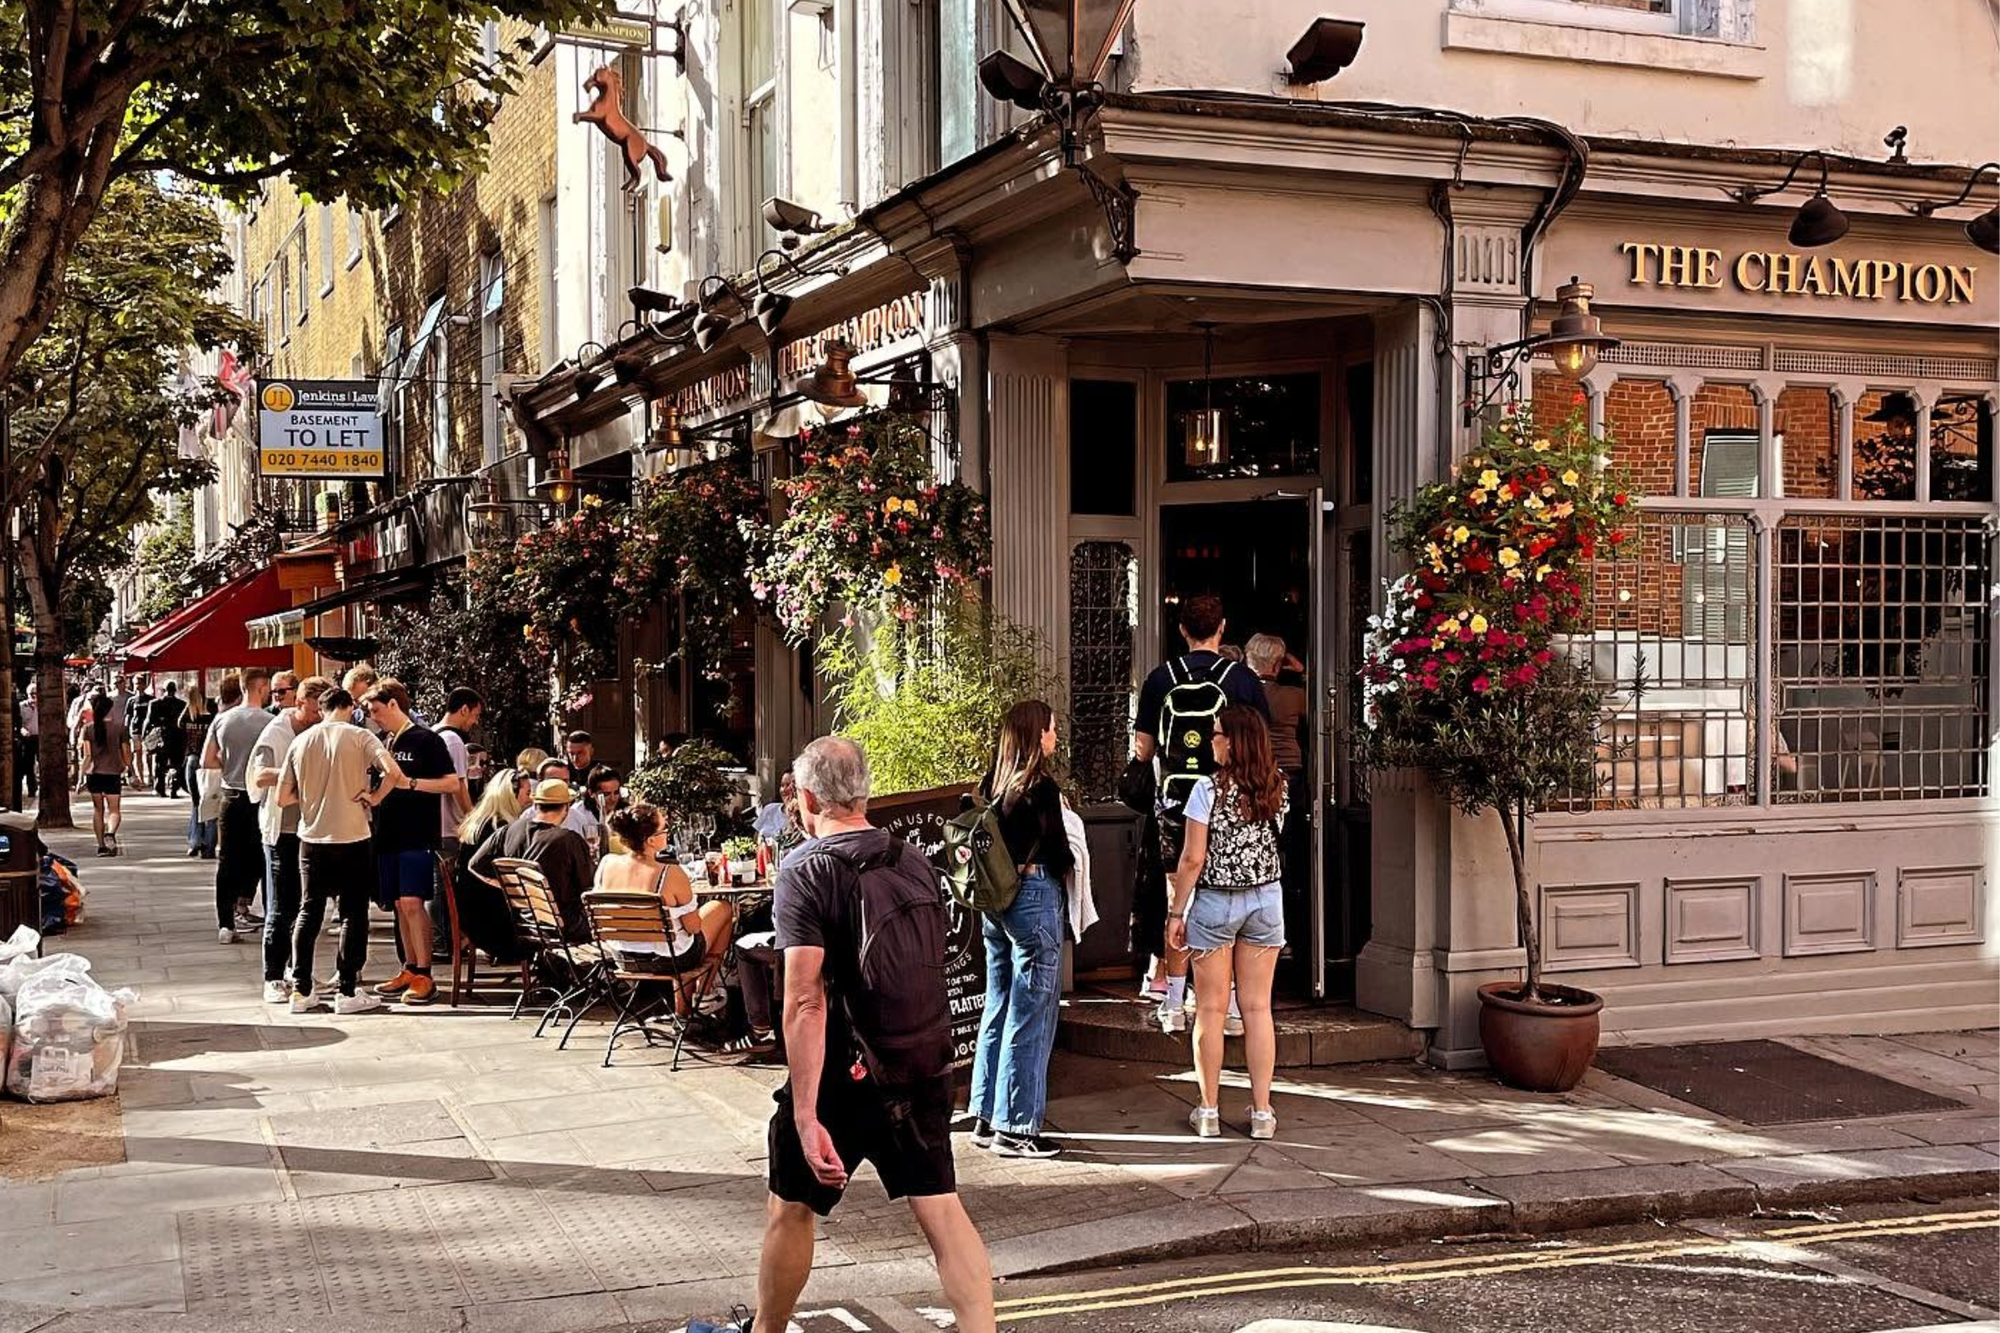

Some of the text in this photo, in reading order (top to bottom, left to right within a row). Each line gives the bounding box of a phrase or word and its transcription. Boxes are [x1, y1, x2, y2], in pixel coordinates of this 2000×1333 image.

[590, 23, 645, 39] HAMPION
[1623, 242, 1978, 304] THE CHAMPION
[779, 335, 813, 378] THE
[297, 389, 378, 406] Jenkins Law
[676, 364, 747, 415] CHAMPION
[290, 414, 359, 426] BASEMENT
[284, 429, 370, 448] TO LET
[267, 453, 379, 467] 020 7440 1840
[881, 813, 951, 833] OIN US FO
